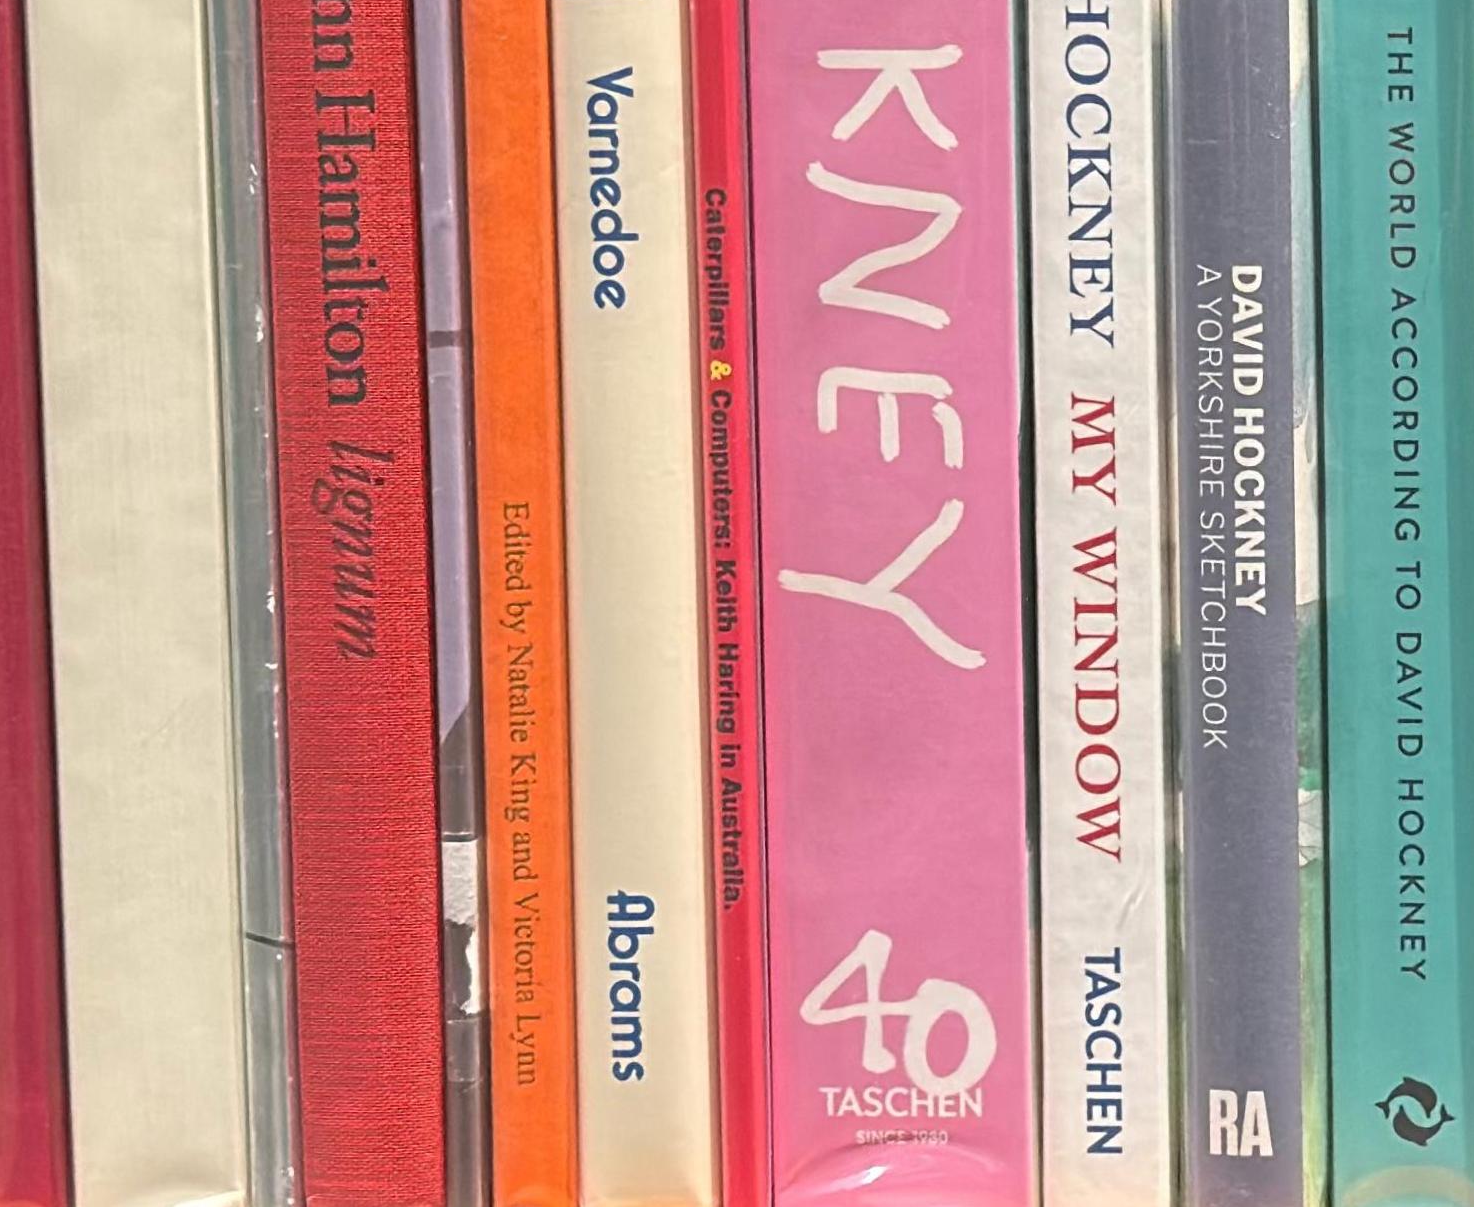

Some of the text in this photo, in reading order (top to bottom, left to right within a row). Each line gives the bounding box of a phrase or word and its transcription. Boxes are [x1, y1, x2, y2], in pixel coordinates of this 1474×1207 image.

[315, 89, 390, 407] Hamilton
[586, 66, 639, 310] Varnedoe
[704, 187, 731, 352] Caterpillars
[710, 360, 733, 382] &
[1071, 391, 1117, 506] MY
[1231, 265, 1267, 617] DAVID HOCKNEY
[311, 441, 394, 661] lignum
[709, 388, 734, 550] Computers:
[1196, 263, 1229, 750] A YORKSHIRE SKETCHBOOK
[1387, 26, 1427, 981] THE WORLD ACCORDING TO DAVID HOCKNEY
[715, 559, 738, 633] Keith
[715, 642, 740, 735] Haring
[720, 743, 742, 768] in
[1072, 525, 1122, 864] WINDOW
[500, 501, 543, 1086] Edited by Natalie King and Victoria Lynn
[606, 890, 656, 1083] Abrams
[799, 929, 997, 1096] 40
[1084, 947, 1124, 1155] TASCHEN
[819, 1087, 983, 1118] TASCHEN
[1209, 1089, 1273, 1157] RA
